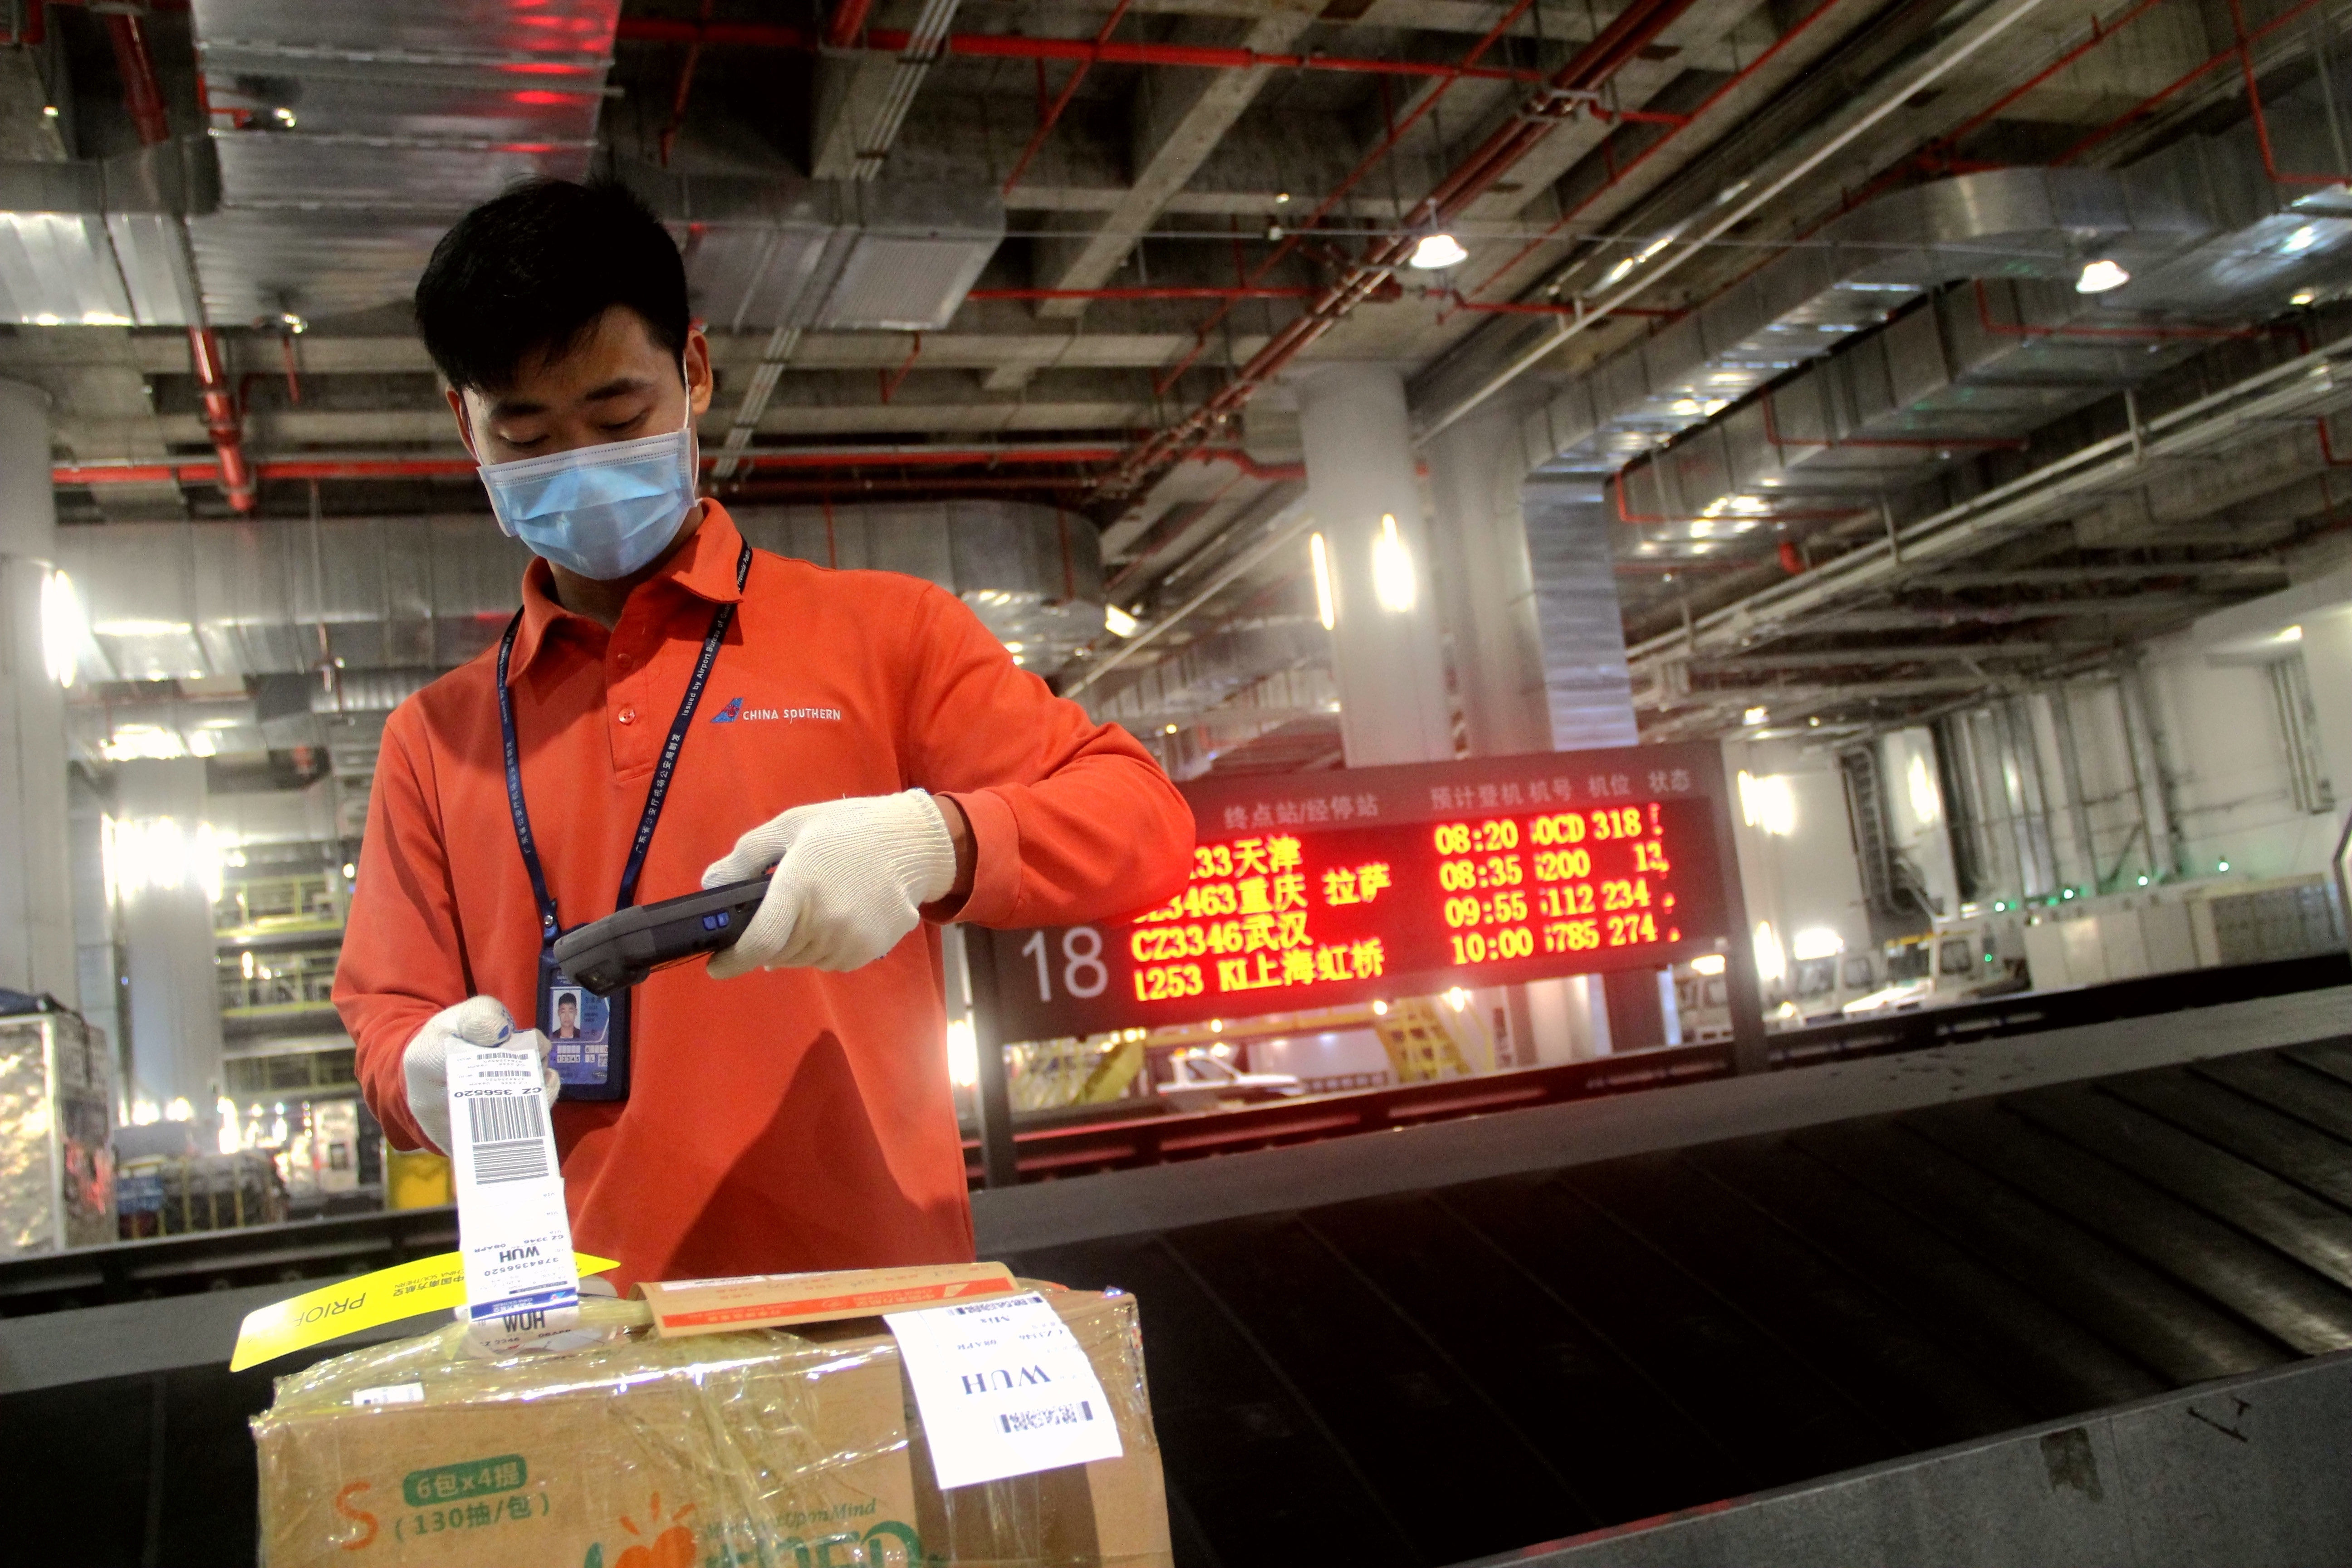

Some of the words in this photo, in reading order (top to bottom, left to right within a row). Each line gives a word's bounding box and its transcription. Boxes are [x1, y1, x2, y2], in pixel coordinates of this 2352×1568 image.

[681, 692, 696, 716] Issued
[692, 681, 701, 691] by
[697, 652, 711, 679] Airport
[706, 629, 721, 652] Bureau
[743, 709, 779, 720] CHINA
[783, 708, 841, 720] SOUTHERN
[1225, 794, 1379, 829] 终点站/经停站
[1589, 774, 1631, 799] 机位
[1649, 768, 1691, 793] 状态
[1434, 818, 1519, 856] 08:20
[1592, 807, 1642, 841] 318
[1322, 861, 1392, 907] 拉萨
[1440, 854, 1524, 892] 08:35
[1445, 890, 1528, 929] 09:55
[1601, 878, 1651, 912] 234
[1451, 926, 1534, 965] 10:00
[1607, 913, 1658, 948] 274
[1022, 927, 1109, 1002] 18
[454, 1088, 513, 1098] 356520
[474, 1243, 507, 1253] 08APR
[499, 1245, 540, 1263] WUH
[484, 1257, 559, 1277] 3784356520
[392, 1275, 465, 1298] 中国南方航空
[503, 1311, 546, 1333] WUH
[960, 1364, 1051, 1395] WUH
[336, 1481, 379, 1551] S
[832, 1497, 877, 1520] Mind
